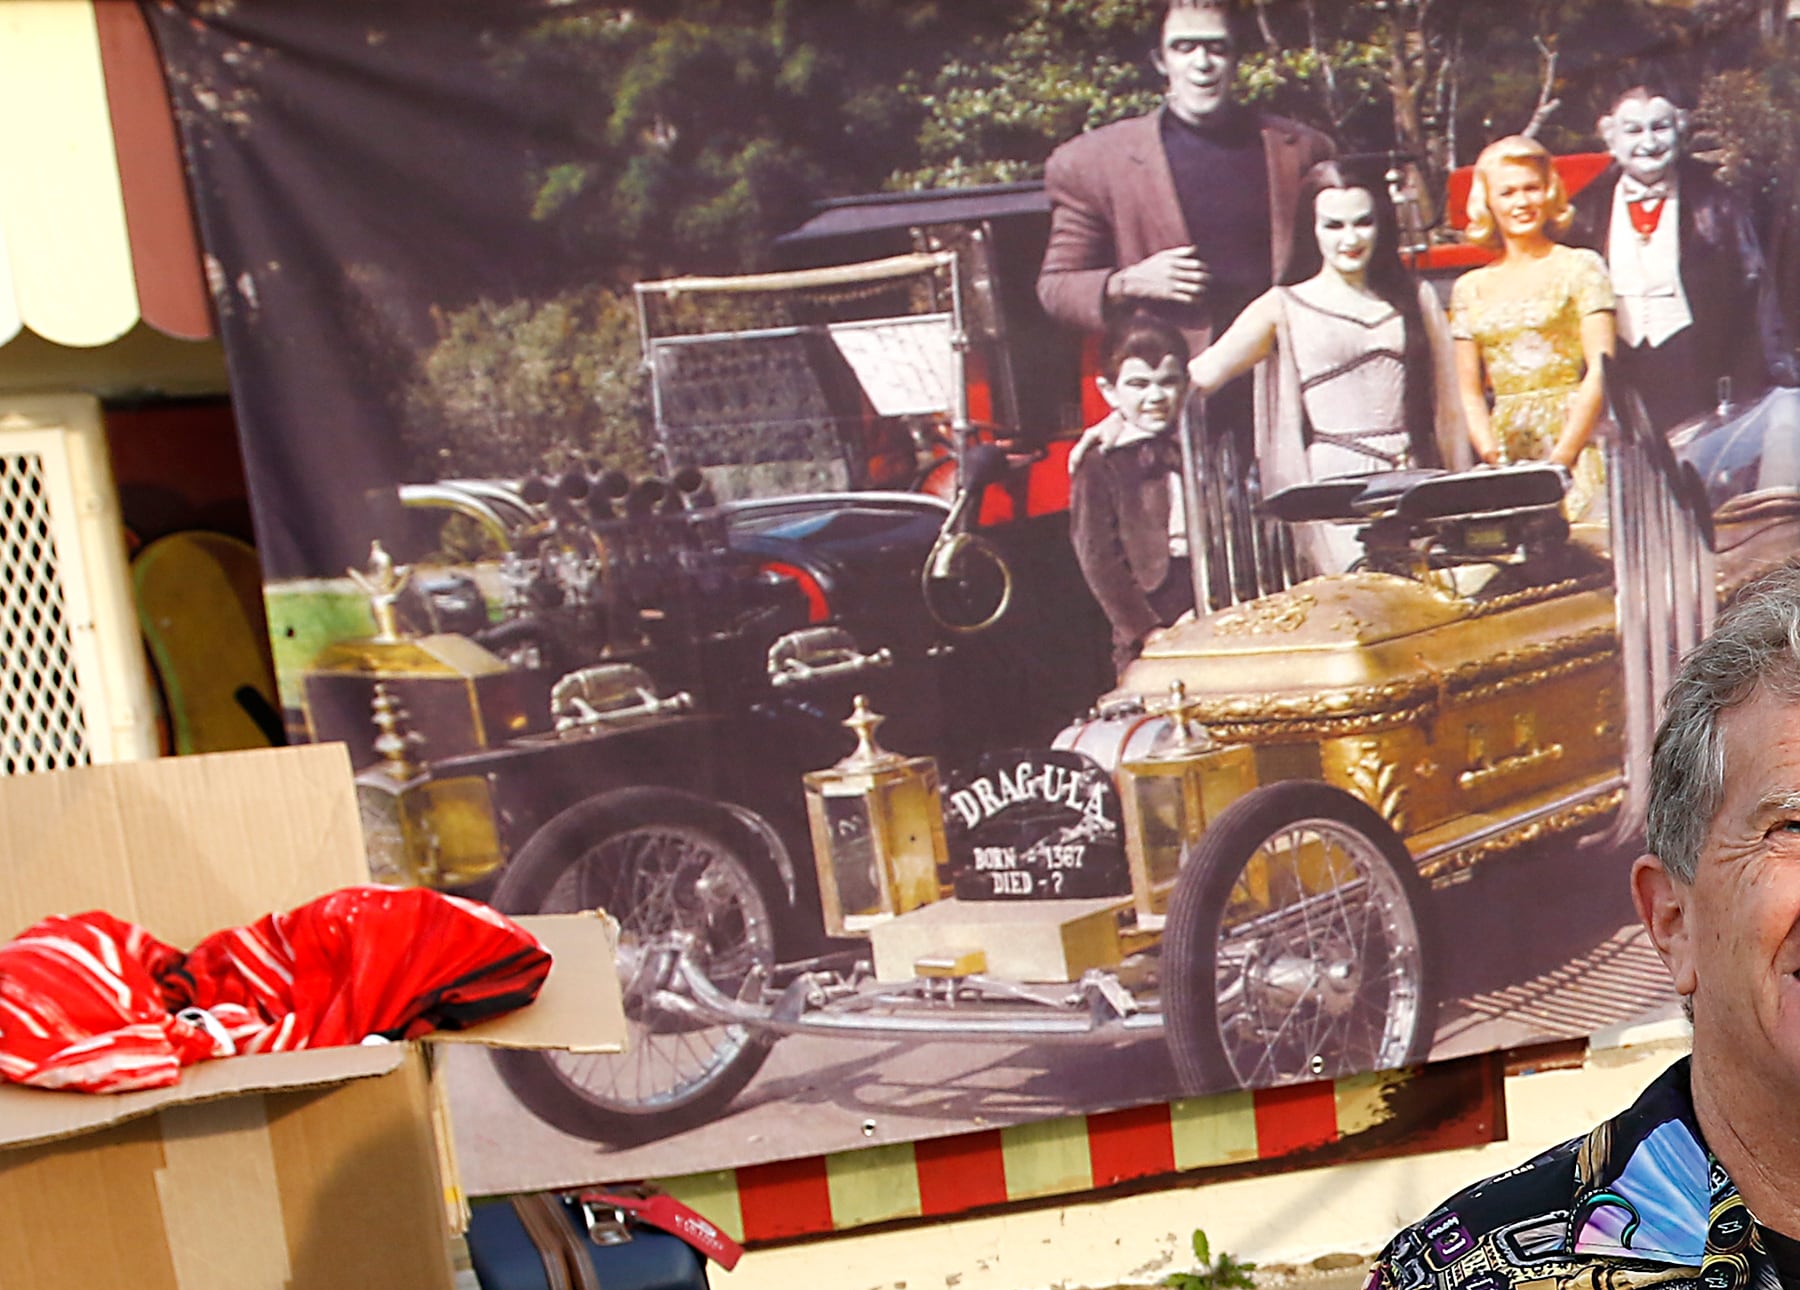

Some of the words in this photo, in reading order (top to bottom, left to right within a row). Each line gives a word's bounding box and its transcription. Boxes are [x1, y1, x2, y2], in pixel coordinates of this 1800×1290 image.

[973, 847, 1016, 870] BORN
[991, 871, 1032, 894] DIED
[1051, 871, 1063, 894] ?
